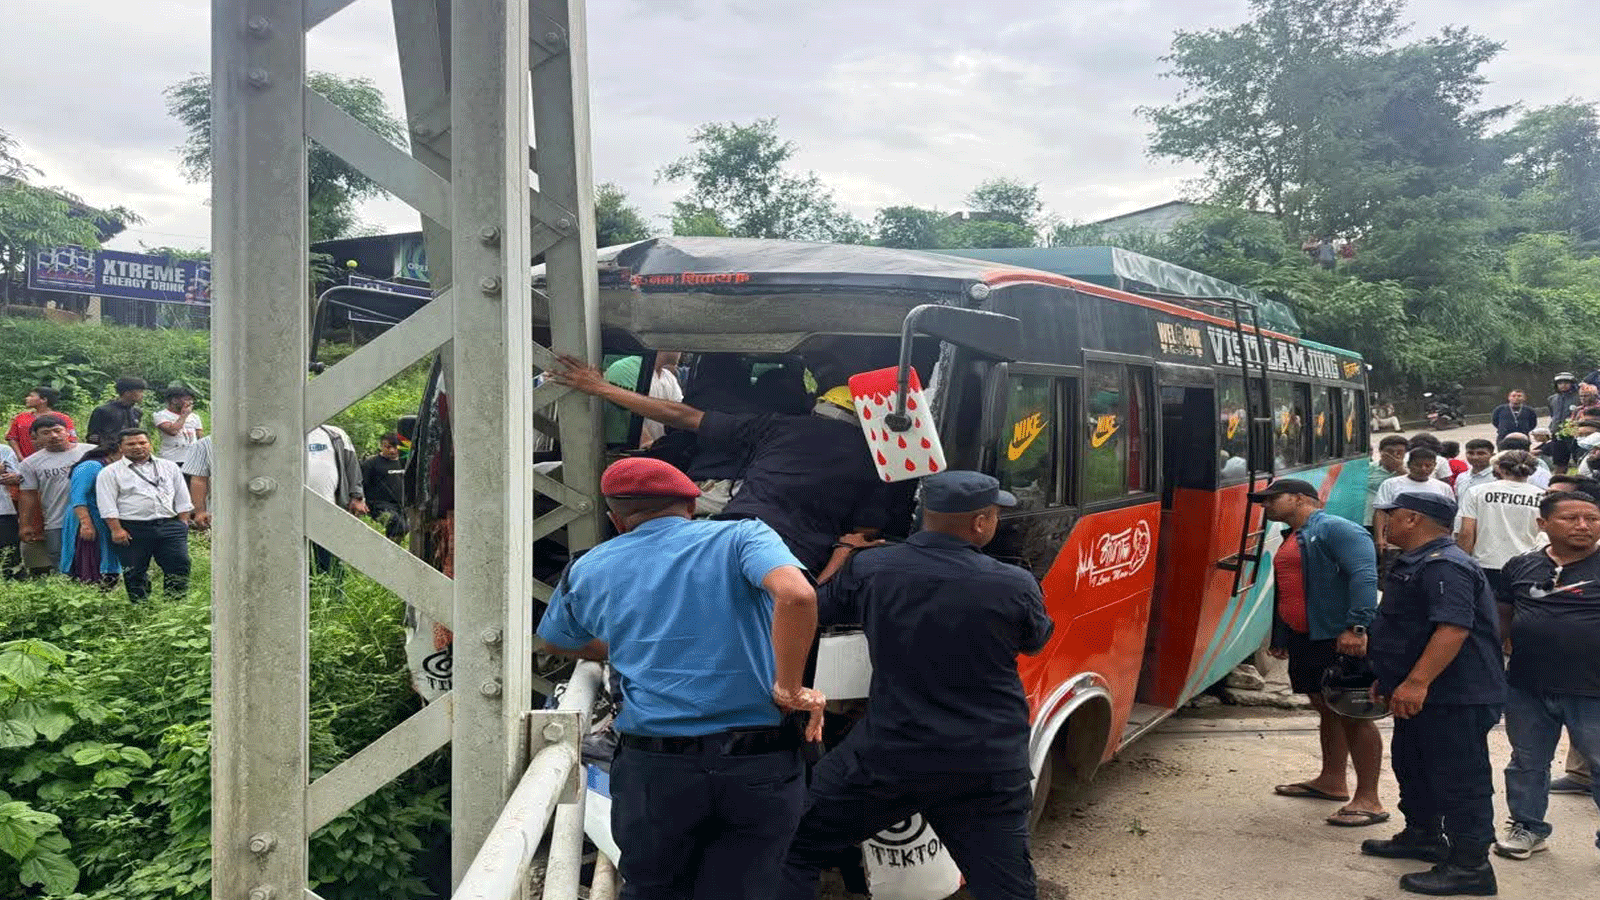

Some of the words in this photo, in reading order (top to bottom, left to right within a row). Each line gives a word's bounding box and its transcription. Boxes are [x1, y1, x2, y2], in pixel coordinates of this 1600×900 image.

[102, 275, 148, 289] ENERGY
[151, 280, 185, 293] DRINK
[103, 259, 186, 283] XTREME
[1207, 325, 1262, 369] VISIT
[1014, 412, 1041, 443] NIKE
[1097, 415, 1117, 434] NIKE
[869, 838, 943, 868] TIKTO
